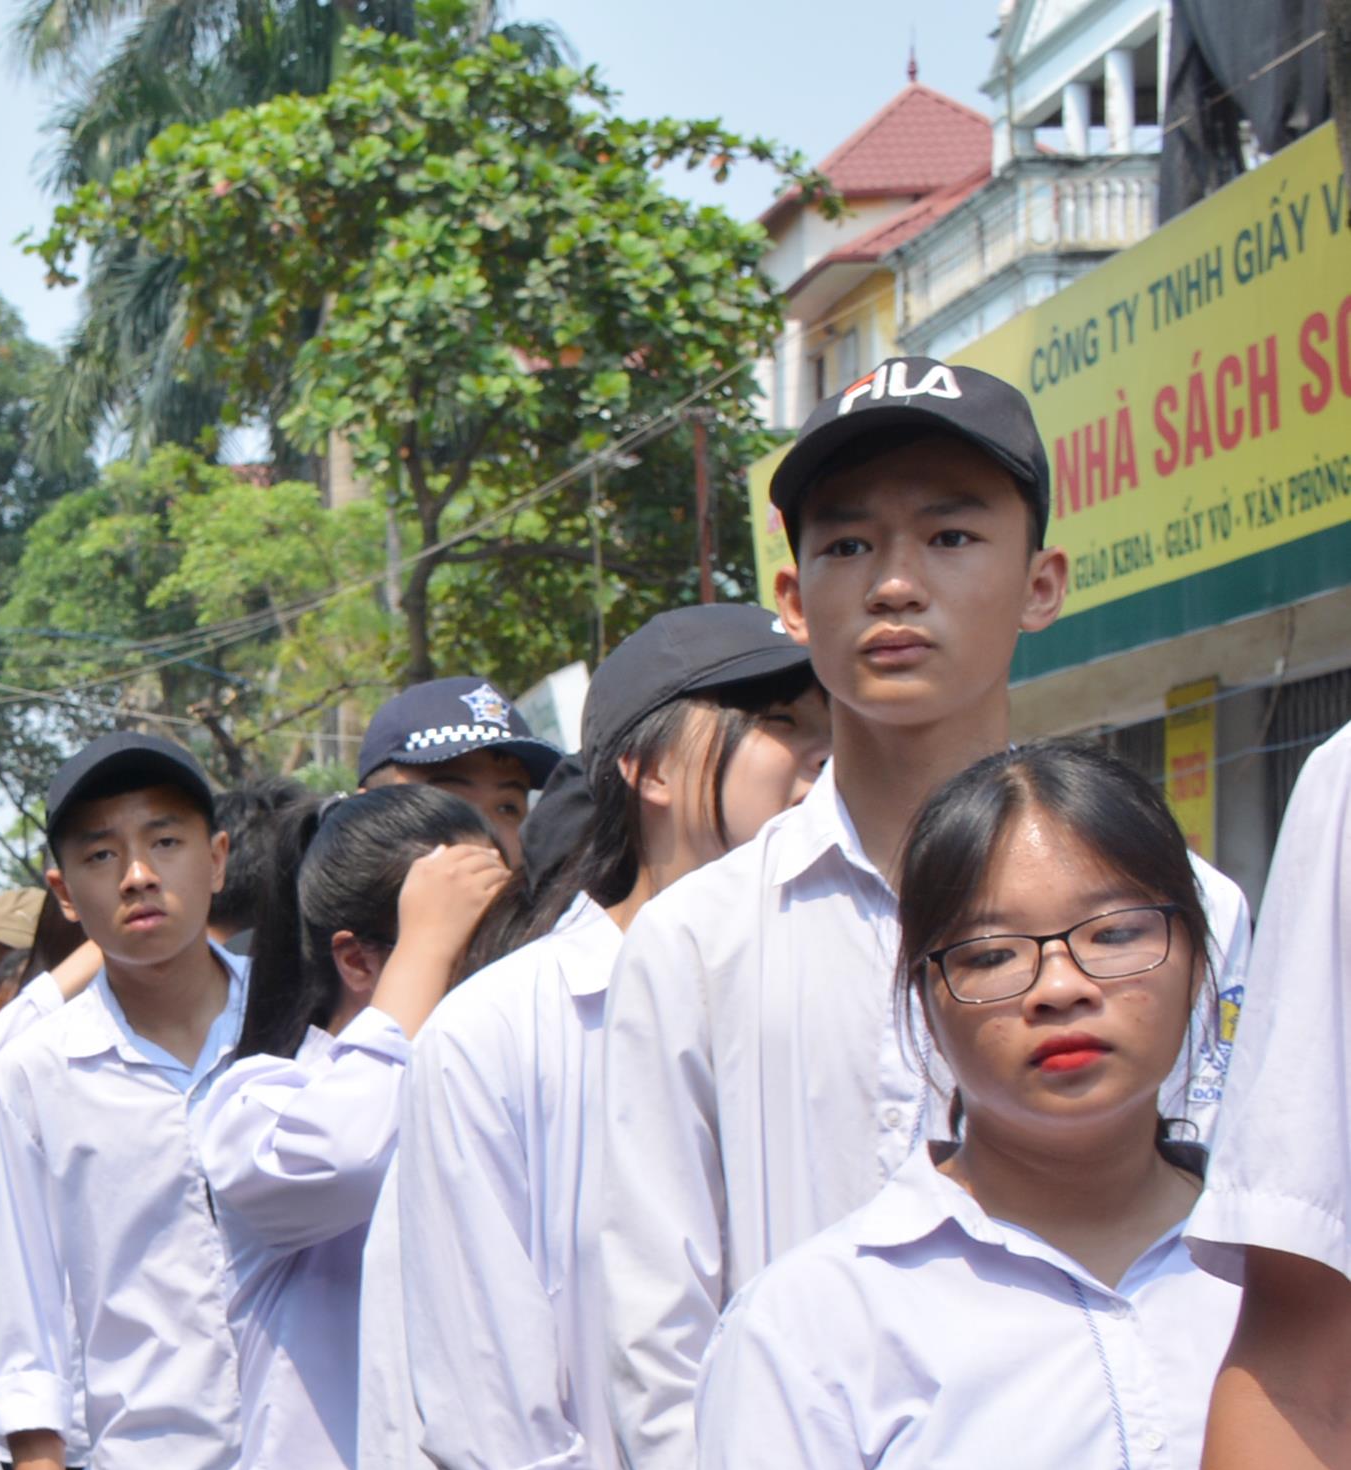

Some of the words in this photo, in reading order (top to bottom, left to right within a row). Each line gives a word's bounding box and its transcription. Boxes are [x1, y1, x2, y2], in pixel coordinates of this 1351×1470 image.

[1030, 326, 1099, 395] CÔNG
[1108, 293, 1139, 353] TY
[1148, 245, 1224, 332] TNHH
[1233, 178, 1310, 286] GIẤY
[838, 361, 962, 416] FILA
[1054, 388, 1139, 520] NHÀ
[1153, 350, 1281, 477] SÁCH
